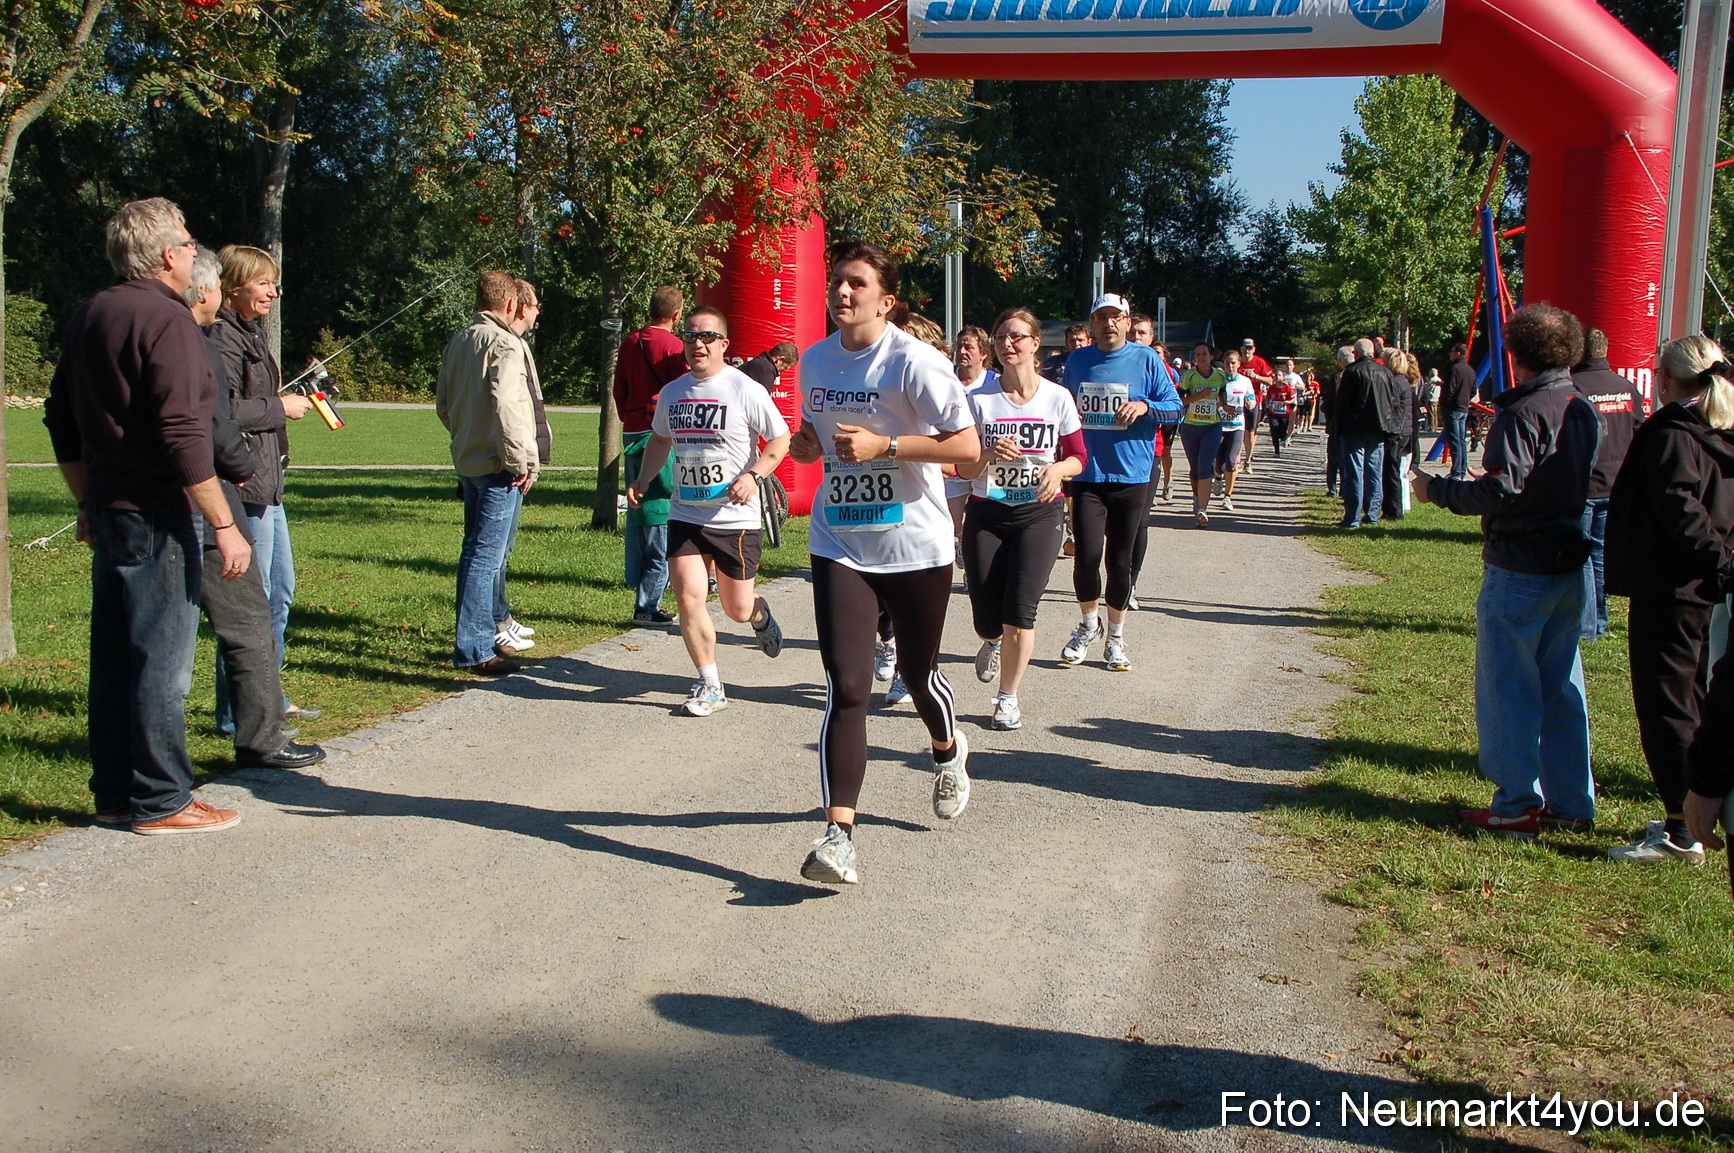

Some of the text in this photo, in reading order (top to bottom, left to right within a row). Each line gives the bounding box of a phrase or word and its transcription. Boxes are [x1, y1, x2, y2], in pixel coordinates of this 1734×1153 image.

[773, 278, 781, 295] 1929
[826, 389, 879, 405] Egner
[1081, 394, 1122, 412] 3010
[669, 404, 693, 416] RADIO
[693, 403, 727, 430] 97.1
[1195, 404, 1211, 414] 863
[985, 423, 1017, 434] RADIO
[1020, 422, 1054, 448] 97.1
[680, 464, 723, 485] 2183
[995, 466, 1040, 488] 3256
[694, 487, 711, 498] Jan
[829, 472, 893, 504] 3238
[1006, 489, 1032, 501] Gesa
[838, 505, 884, 524] Margit
